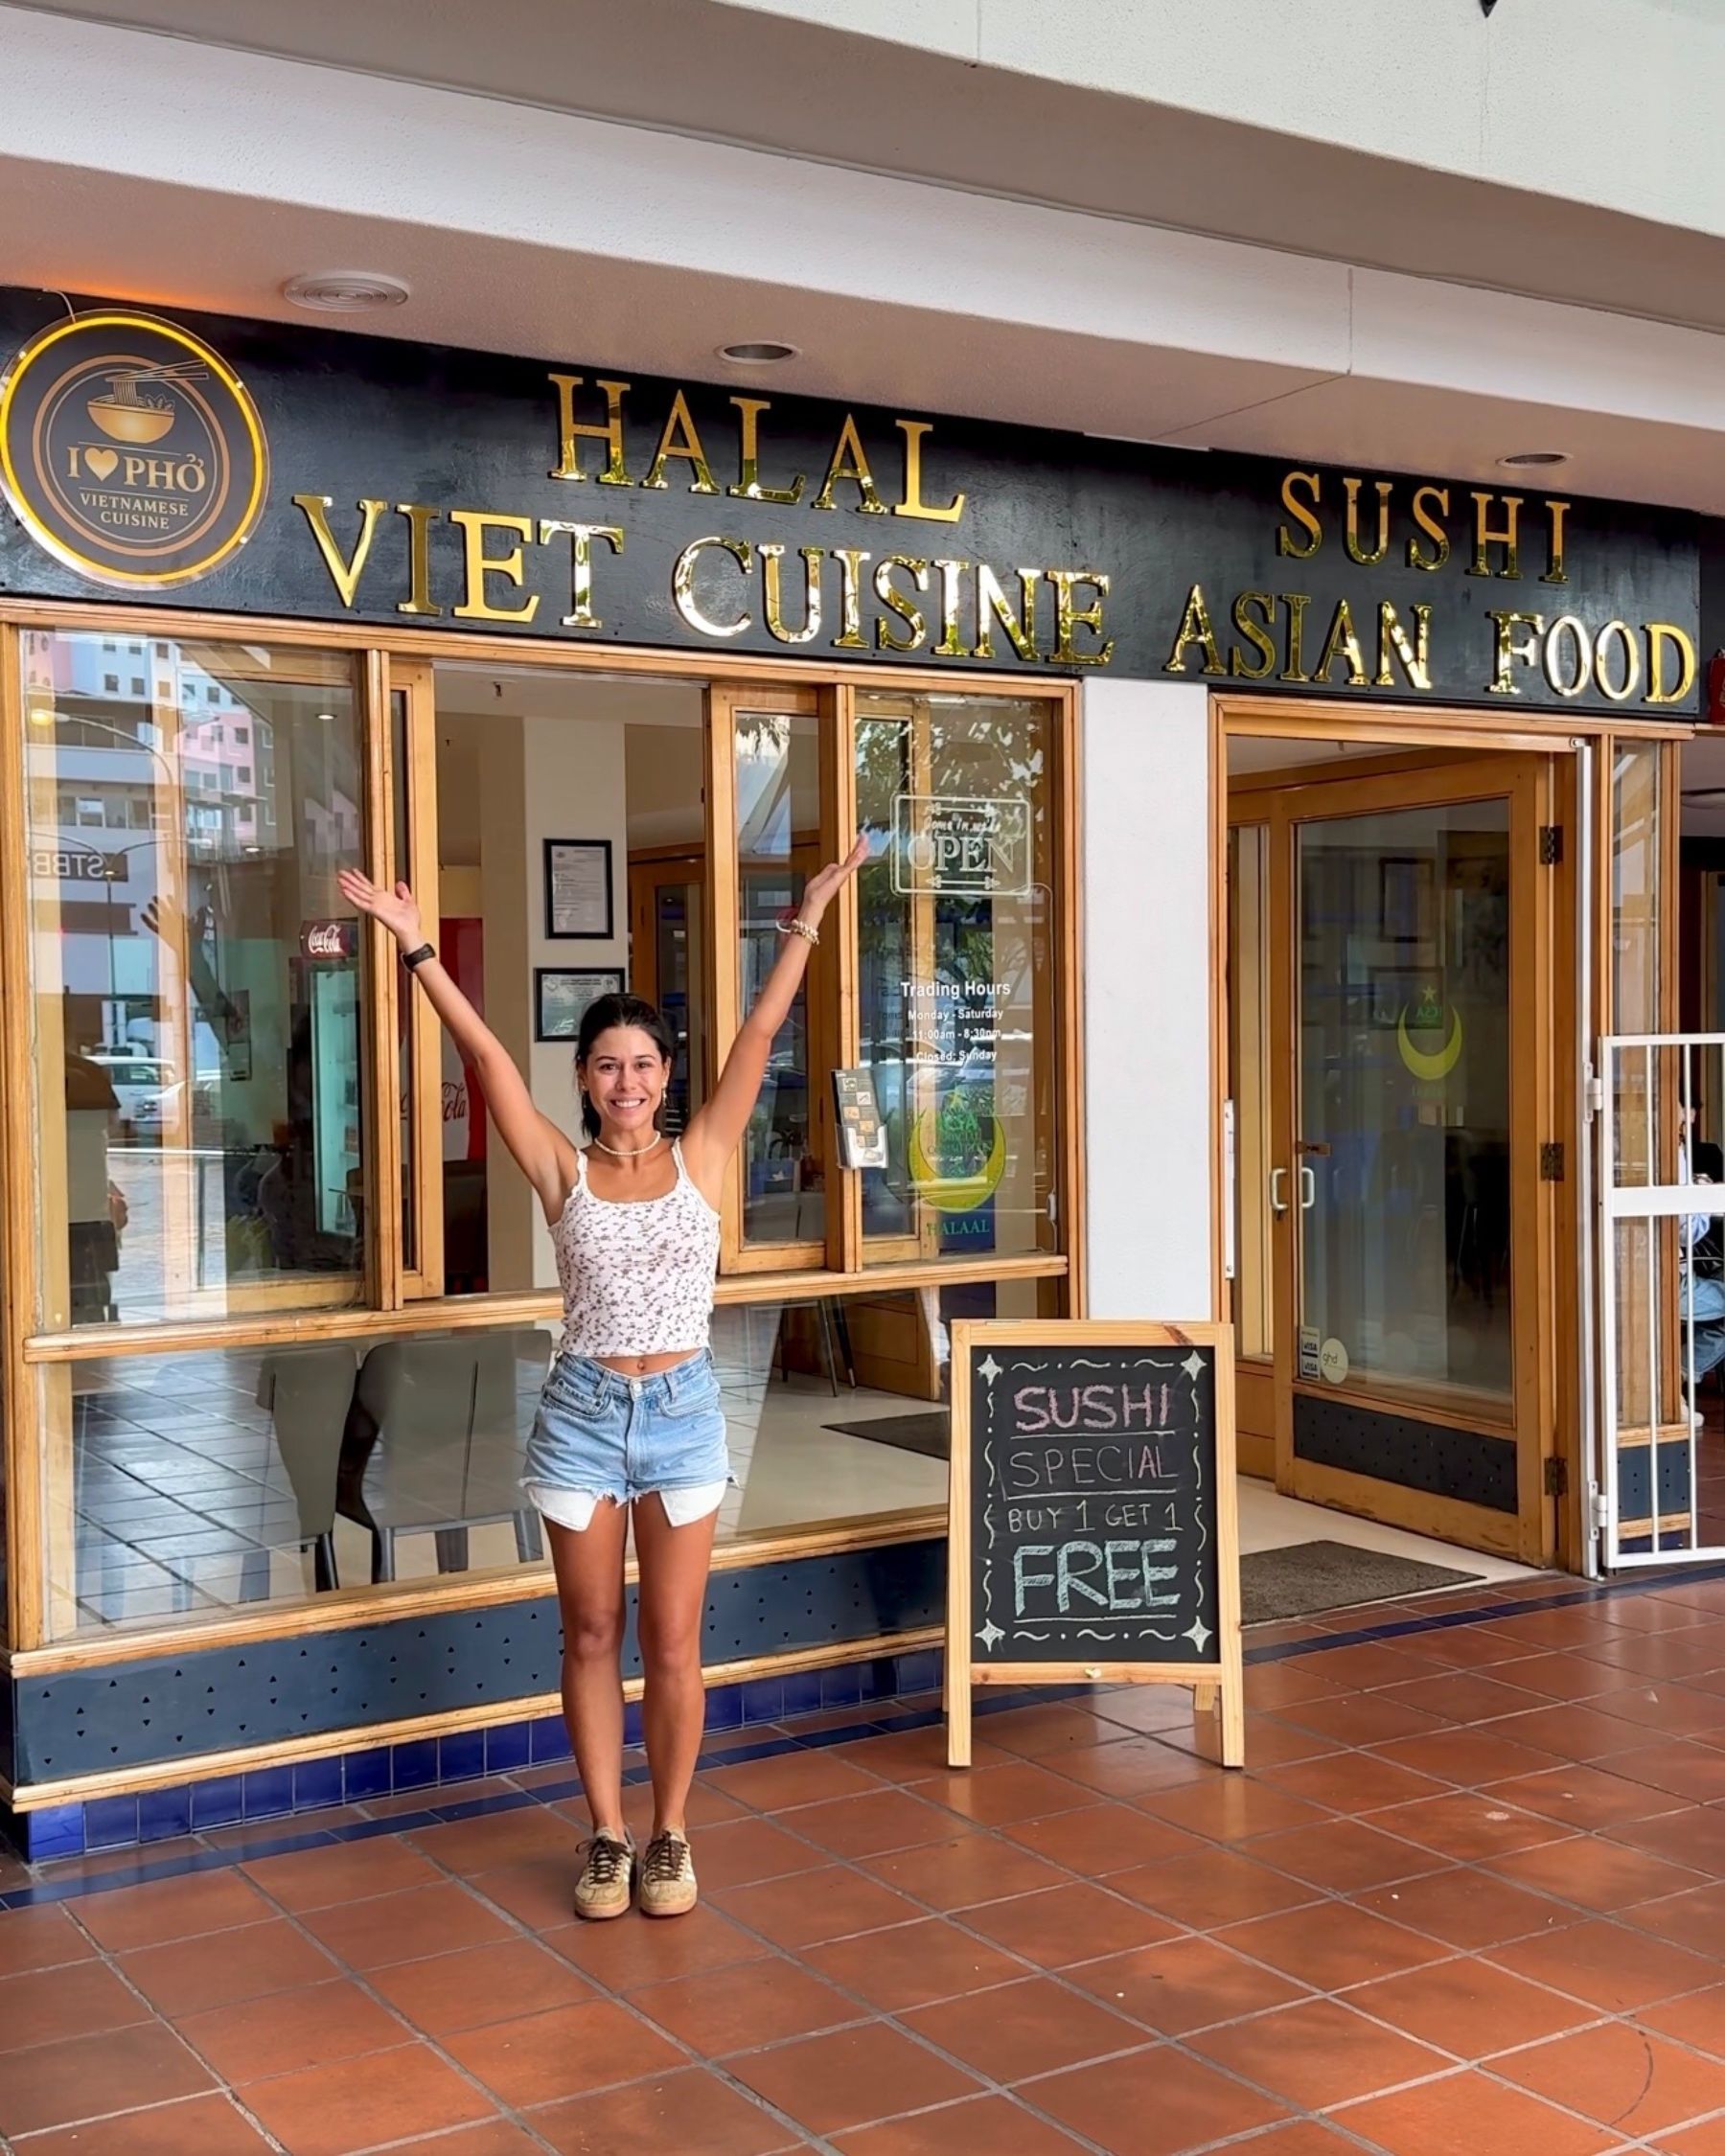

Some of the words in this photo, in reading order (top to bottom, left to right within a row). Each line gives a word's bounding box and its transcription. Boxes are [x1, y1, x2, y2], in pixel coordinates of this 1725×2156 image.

[67, 447, 80, 478] I
[548, 373, 965, 522] HALAL
[80, 493, 189, 516] VIETNAMESE
[101, 511, 170, 530] CUISINE
[1276, 470, 1570, 584] SUSHI
[292, 495, 624, 629] VIET
[674, 537, 1115, 665] CUISINE
[1165, 584, 1433, 689] ASIAN
[1485, 610, 1696, 704] FOOD
[908, 836, 1014, 873] OPEN
[901, 981, 959, 999] Trading
[965, 981, 1011, 997] Hours
[908, 1010, 949, 1021] Monday
[958, 1008, 1003, 1021] Saturday
[963, 1027, 1001, 1042] 8:30pm
[959, 1049, 998, 1062] Sunday
[927, 1219, 989, 1236] HALAAL
[1322, 1352, 1338, 1365] ghd
[1014, 1384, 1168, 1431] SUSHI
[1010, 1446, 1179, 1487] SPECIAL
[1008, 1507, 1062, 1533] BUY
[1073, 1500, 1095, 1531] 1
[1105, 1503, 1151, 1527] GET
[1164, 1502, 1184, 1531] 1
[1013, 1538, 1181, 1617] FREE
